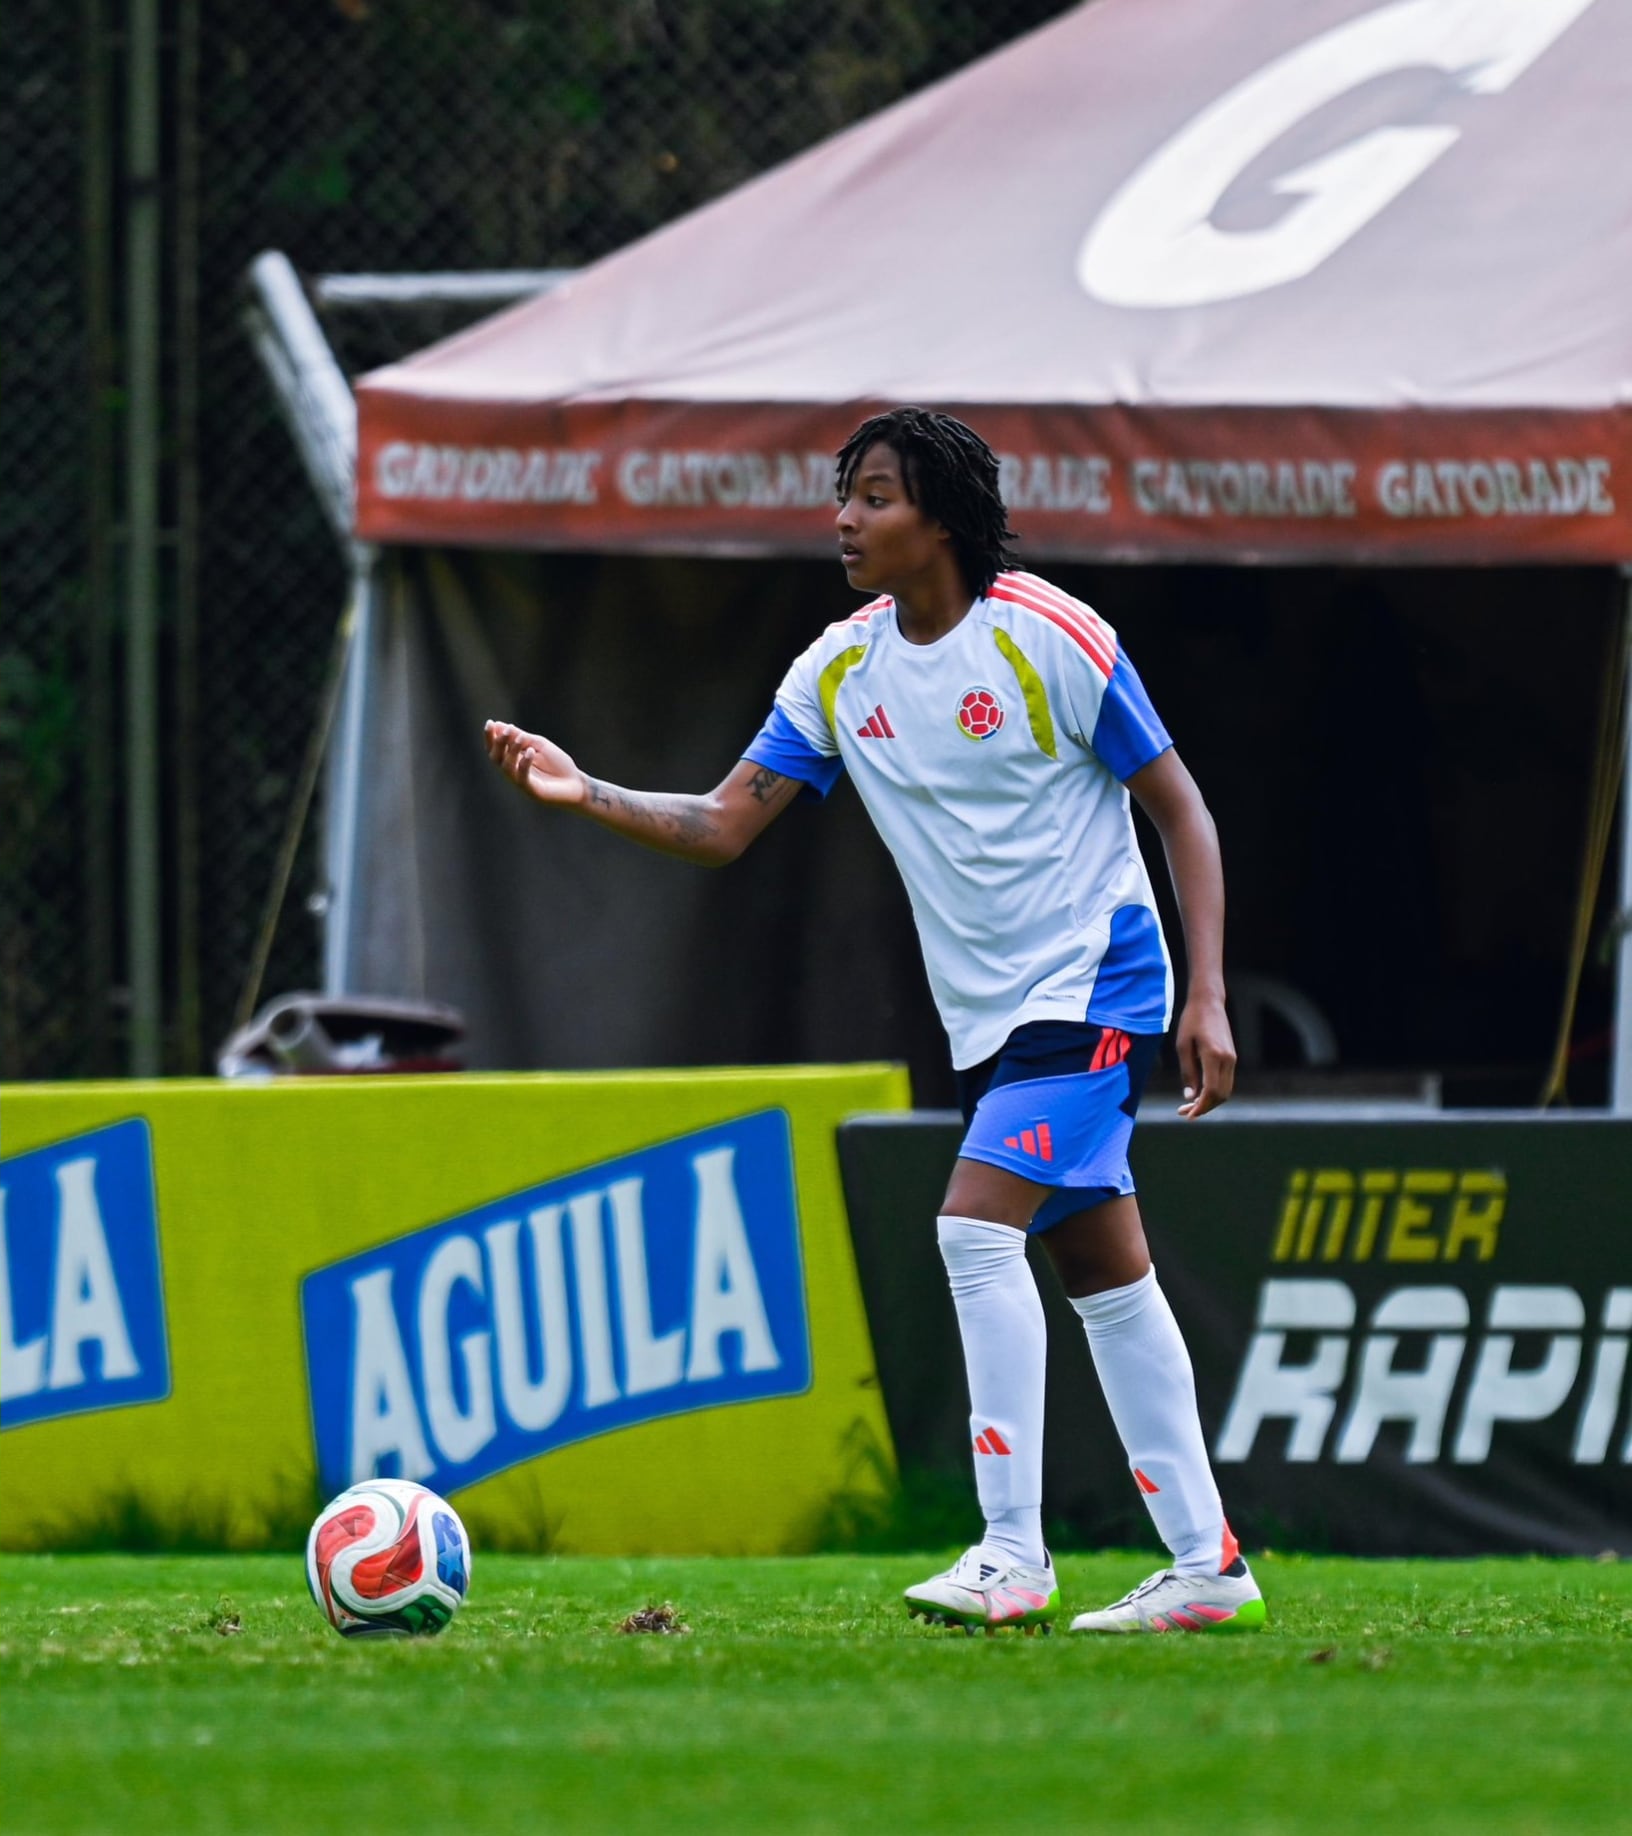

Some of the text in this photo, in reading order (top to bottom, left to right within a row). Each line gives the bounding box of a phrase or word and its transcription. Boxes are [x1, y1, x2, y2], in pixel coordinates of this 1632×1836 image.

[1076, 0, 1594, 310] G
[375, 441, 601, 506] GATORADE
[617, 450, 839, 509] GATORAD
[1129, 457, 1358, 518] GATORADE
[1377, 456, 1615, 518] GATORADE
[1273, 1168, 1508, 1264] INTER
[349, 1146, 784, 1482] AGUILA
[1214, 1277, 1632, 1464] RAPI
